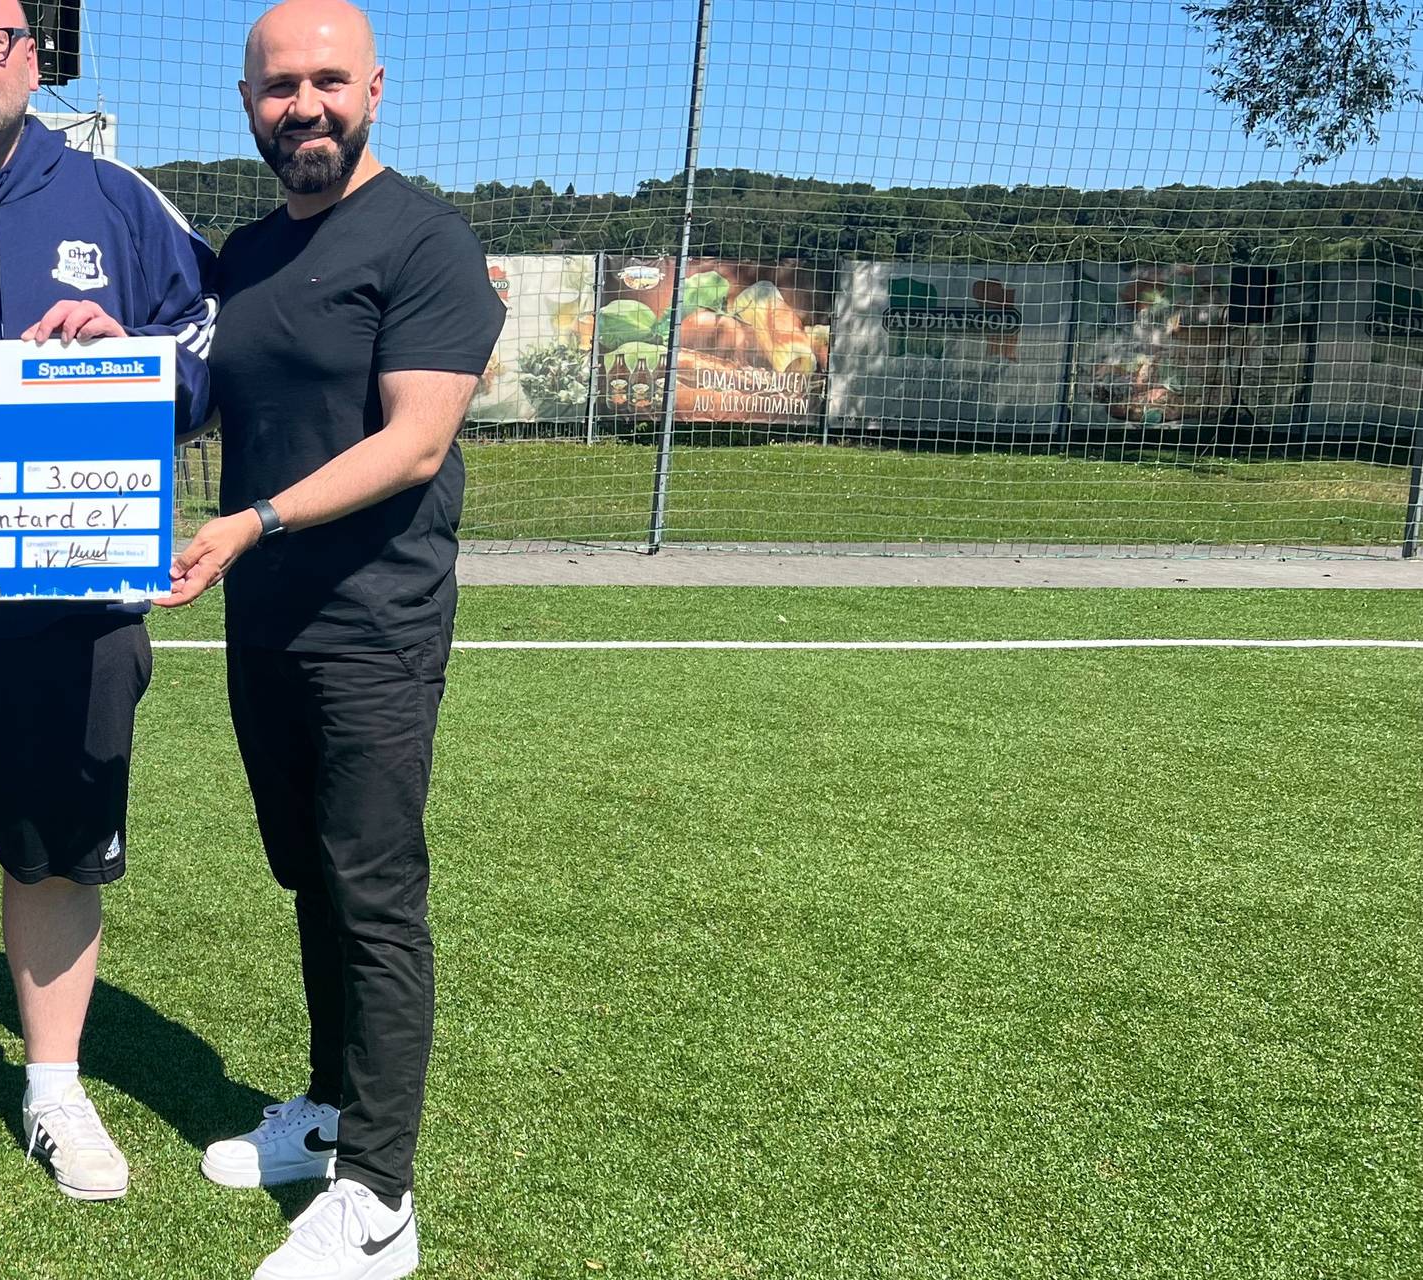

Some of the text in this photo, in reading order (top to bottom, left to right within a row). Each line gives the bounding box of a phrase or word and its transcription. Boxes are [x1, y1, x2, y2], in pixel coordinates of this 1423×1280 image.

[888, 310, 1017, 330] AUDIAFOOD
[38, 360, 145, 379] Sparda-Bank
[695, 368, 810, 393] TOMATENSAUCEN
[693, 395, 715, 412] AUS
[46, 466, 152, 496] 3.000,00
[86, 503, 128, 529] e.V.
